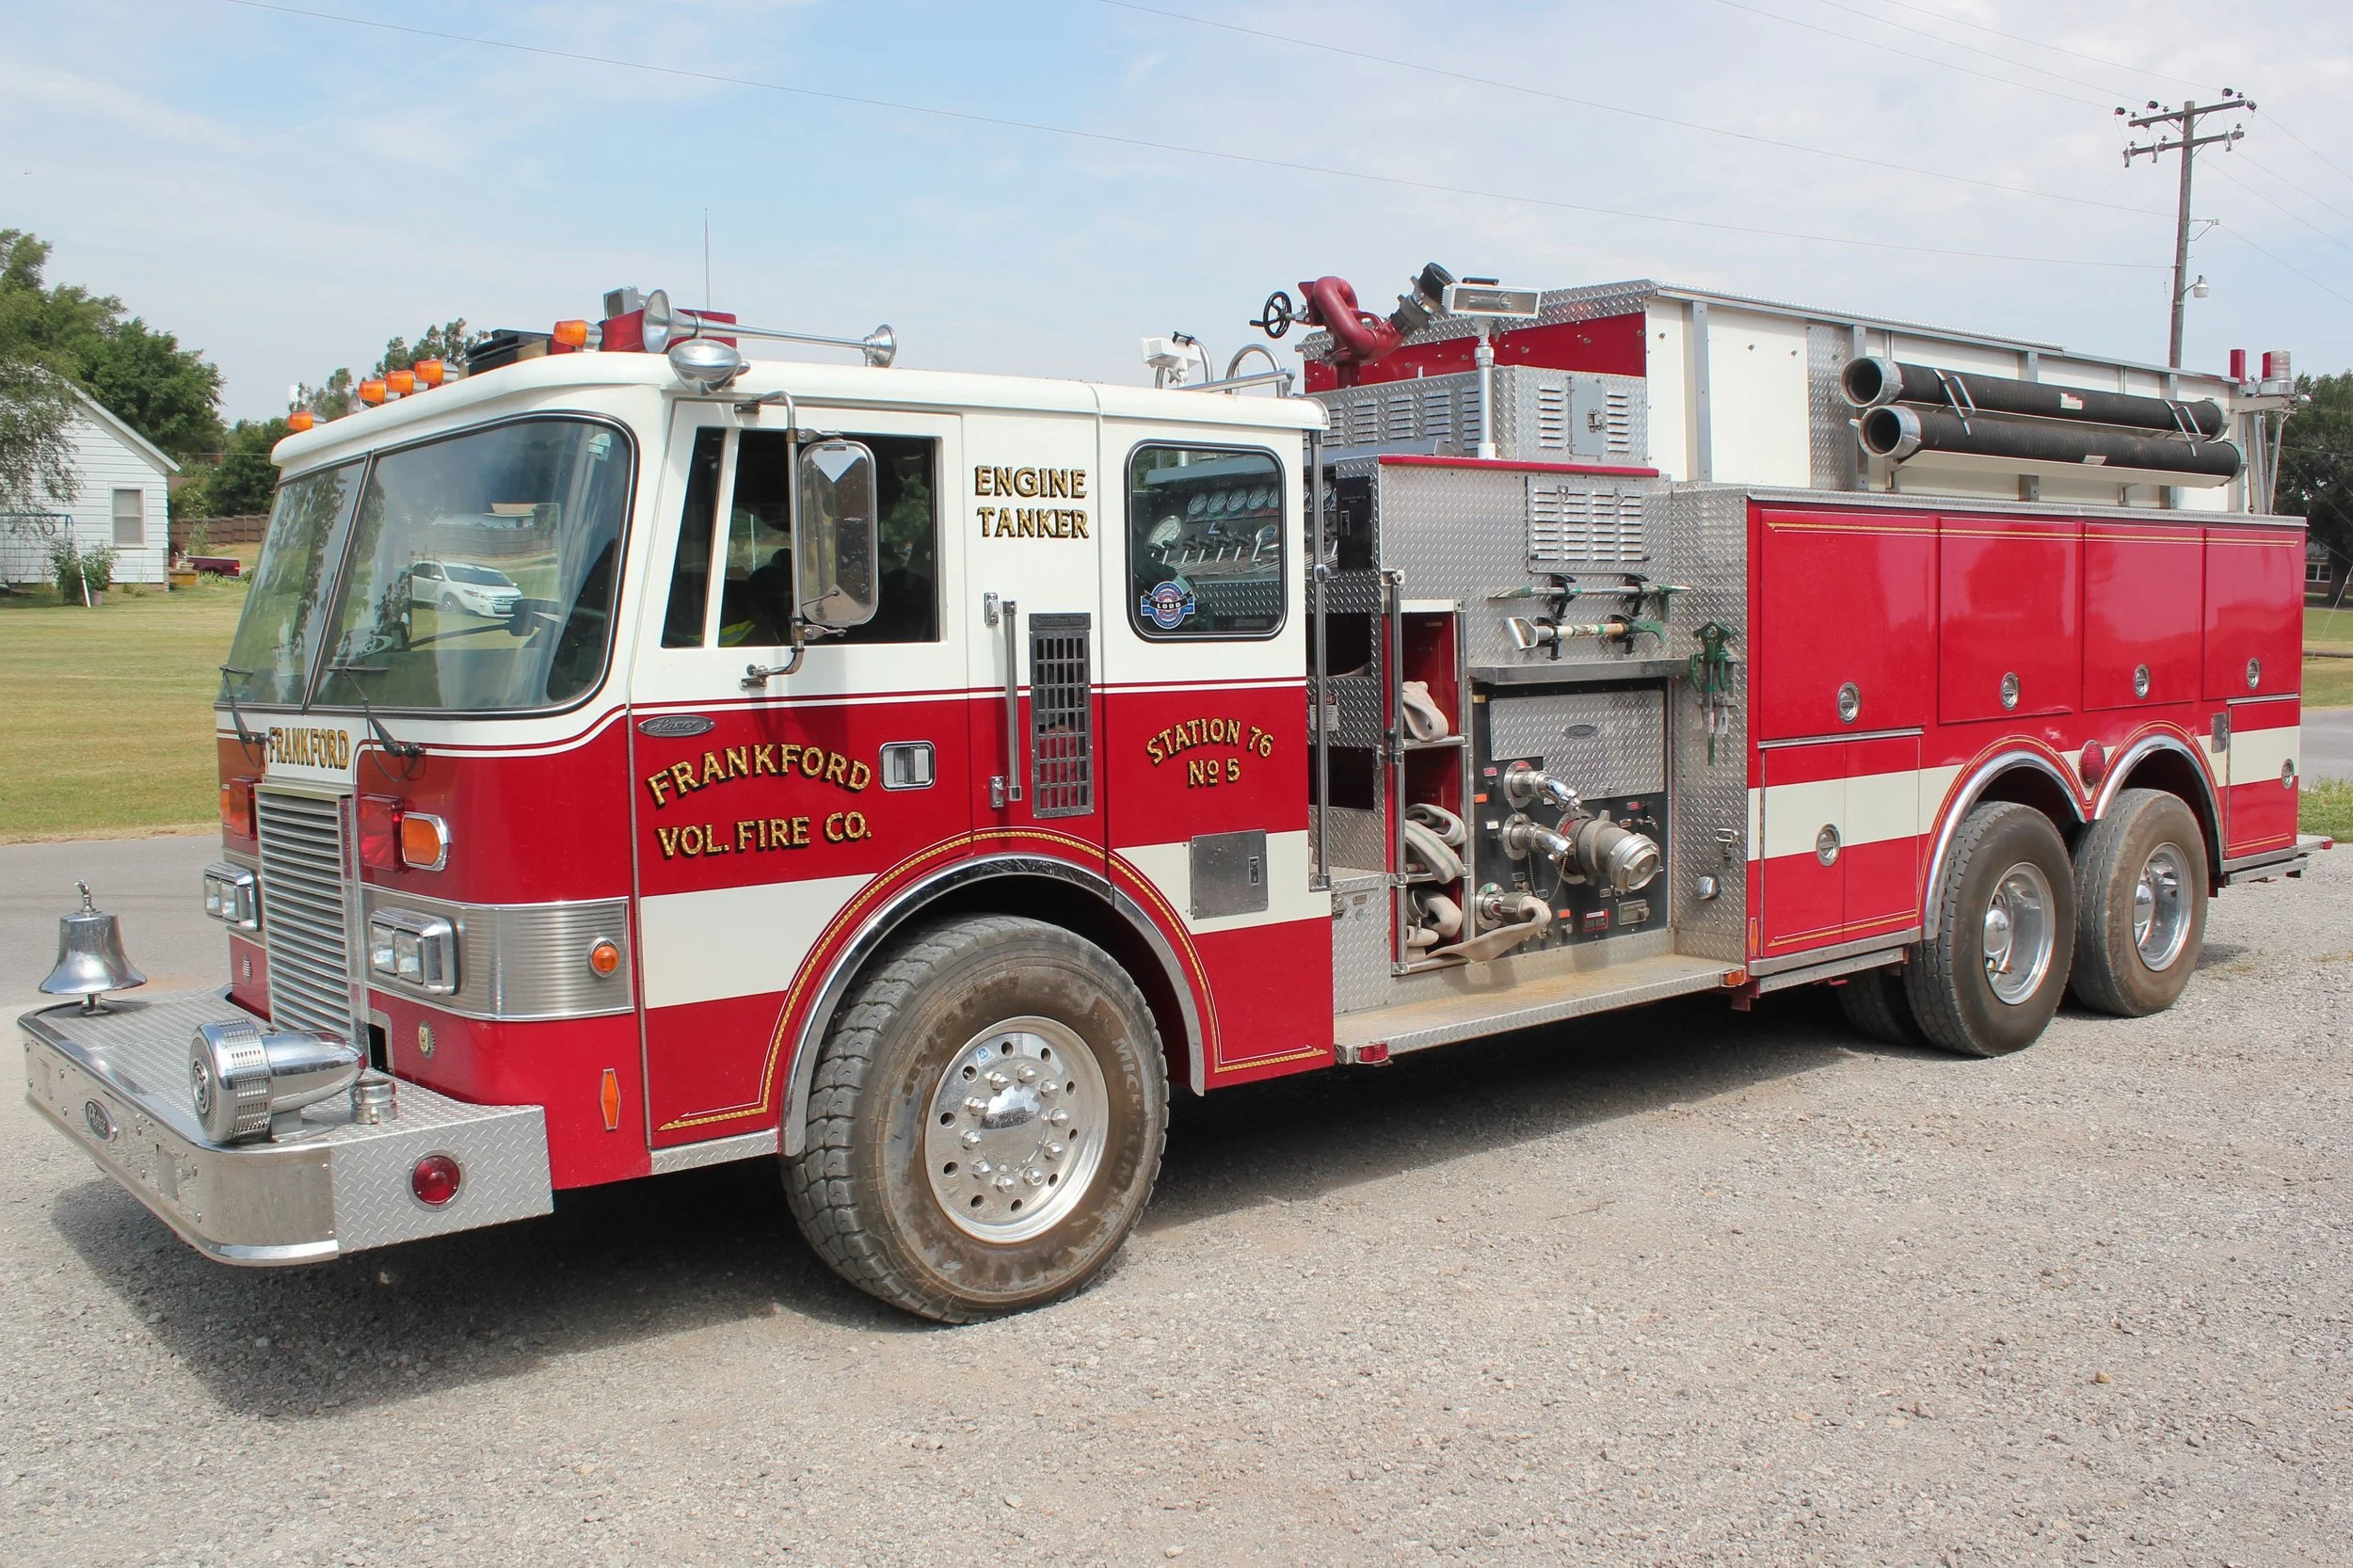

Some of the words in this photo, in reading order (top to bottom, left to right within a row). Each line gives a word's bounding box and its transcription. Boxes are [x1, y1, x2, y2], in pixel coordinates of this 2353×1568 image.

[974, 465, 1087, 499] ENGINE
[976, 506, 1089, 538] TANKER
[269, 727, 349, 770] FRANKFORD
[1146, 717, 1241, 766] STATION
[1247, 726, 1273, 758] 76
[646, 744, 872, 809] FRANKFORD
[1226, 758, 1241, 783] 5
[656, 824, 730, 860] VOL.
[734, 816, 810, 853] FIRE
[823, 810, 872, 843] CO.
